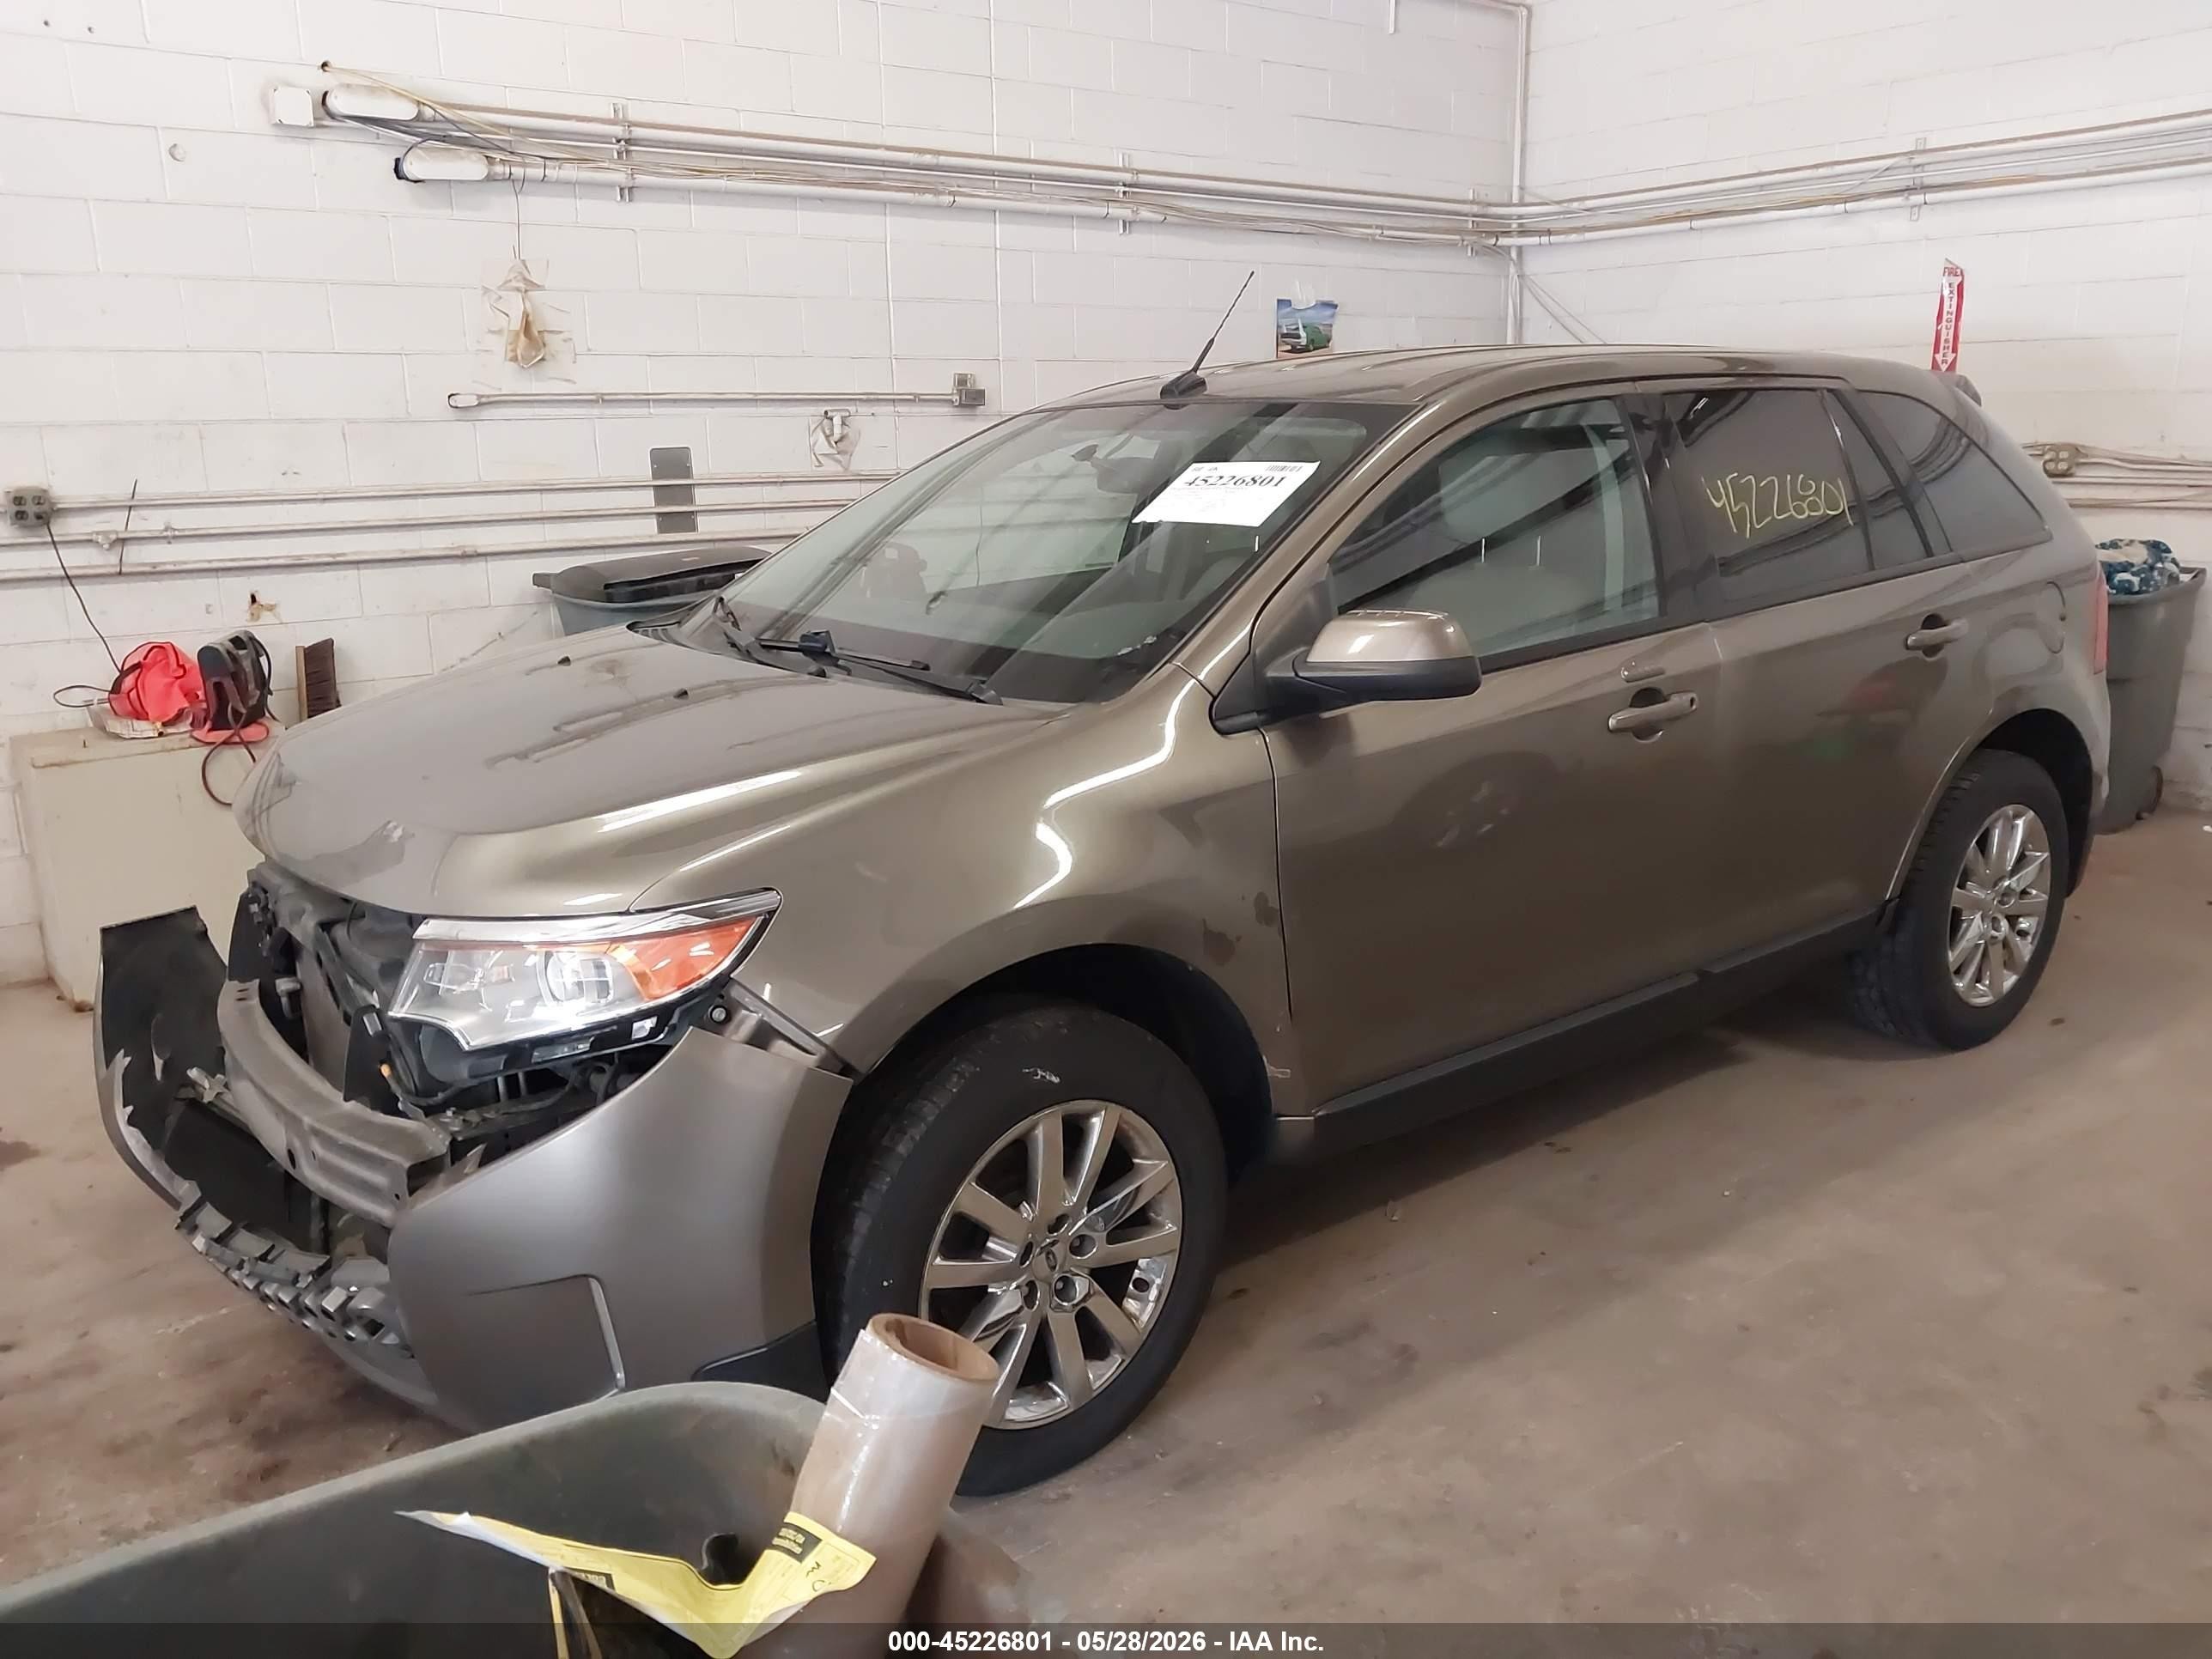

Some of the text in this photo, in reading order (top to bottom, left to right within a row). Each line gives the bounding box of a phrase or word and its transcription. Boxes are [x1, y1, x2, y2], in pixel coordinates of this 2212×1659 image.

[1942, 266, 1960, 276] FIRE
[1941, 282, 1955, 365] EXTINGUISHER
[1183, 474, 1288, 487] 45226801
[1700, 471, 1855, 539] 45226801
